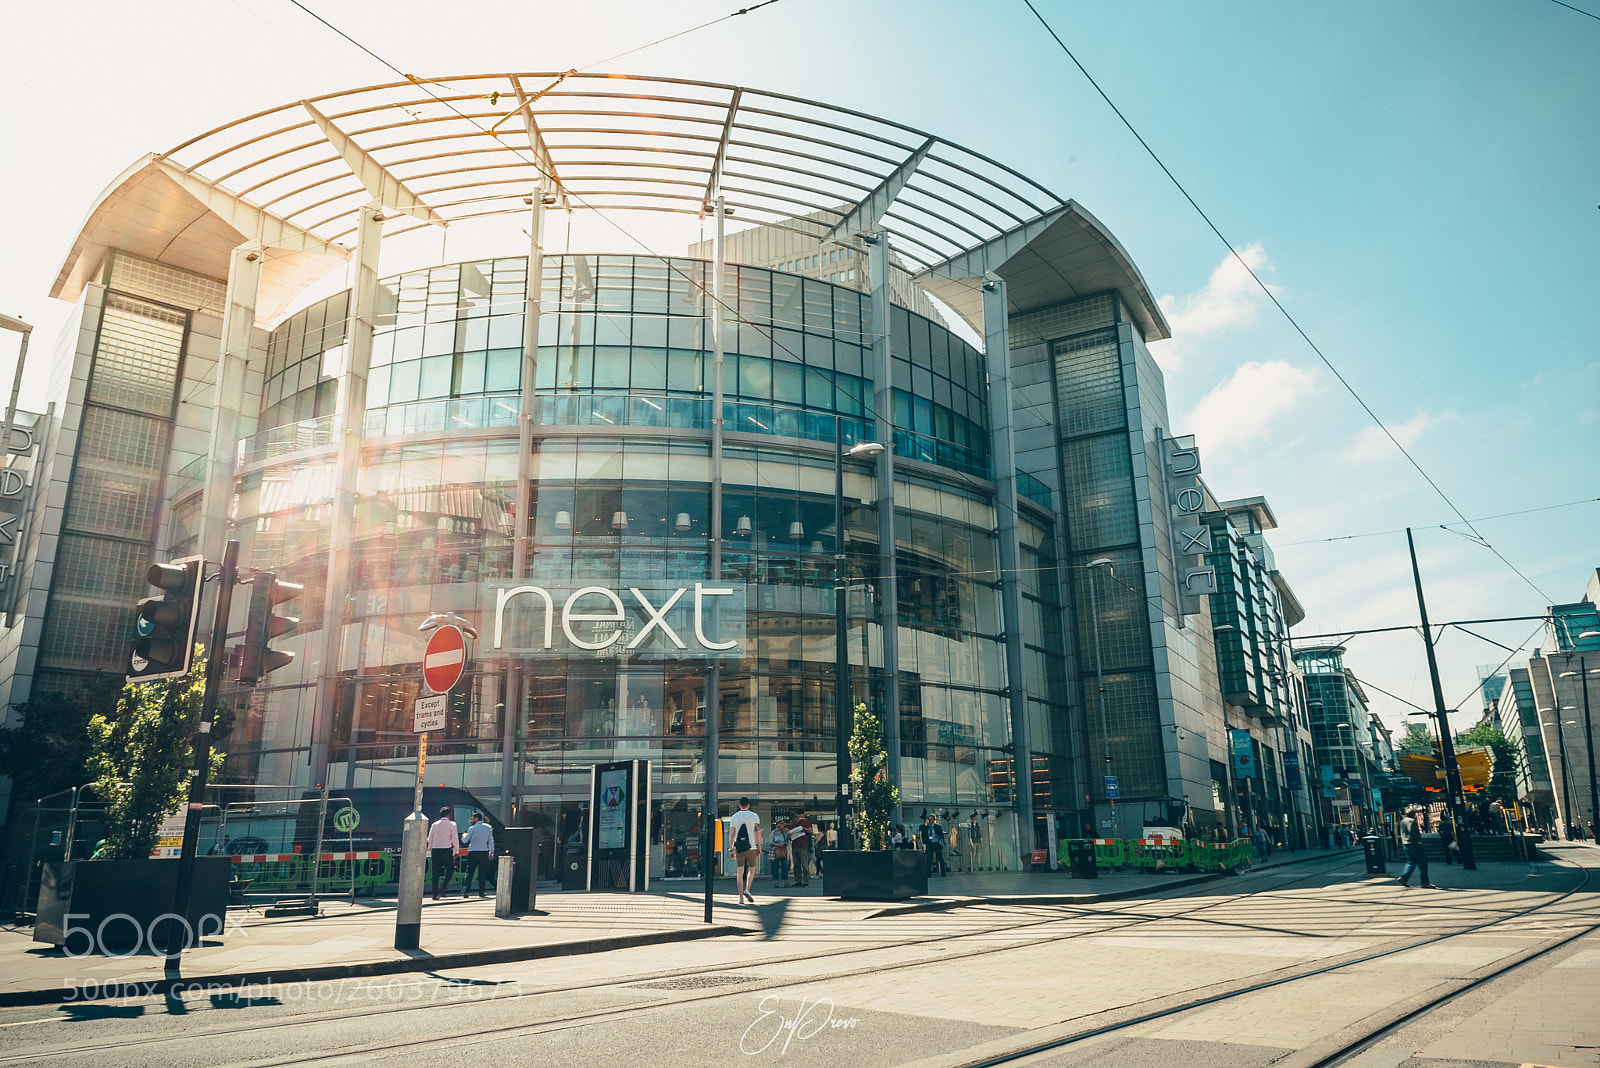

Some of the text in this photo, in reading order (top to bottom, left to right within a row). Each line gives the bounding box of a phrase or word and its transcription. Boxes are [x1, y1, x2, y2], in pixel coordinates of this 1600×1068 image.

[1171, 448, 1215, 590] next
[493, 582, 739, 651] next
[421, 700, 440, 709] Except
[416, 708, 444, 720] trams and
[420, 719, 439, 729] cycles
[232, 842, 260, 855] Ford
